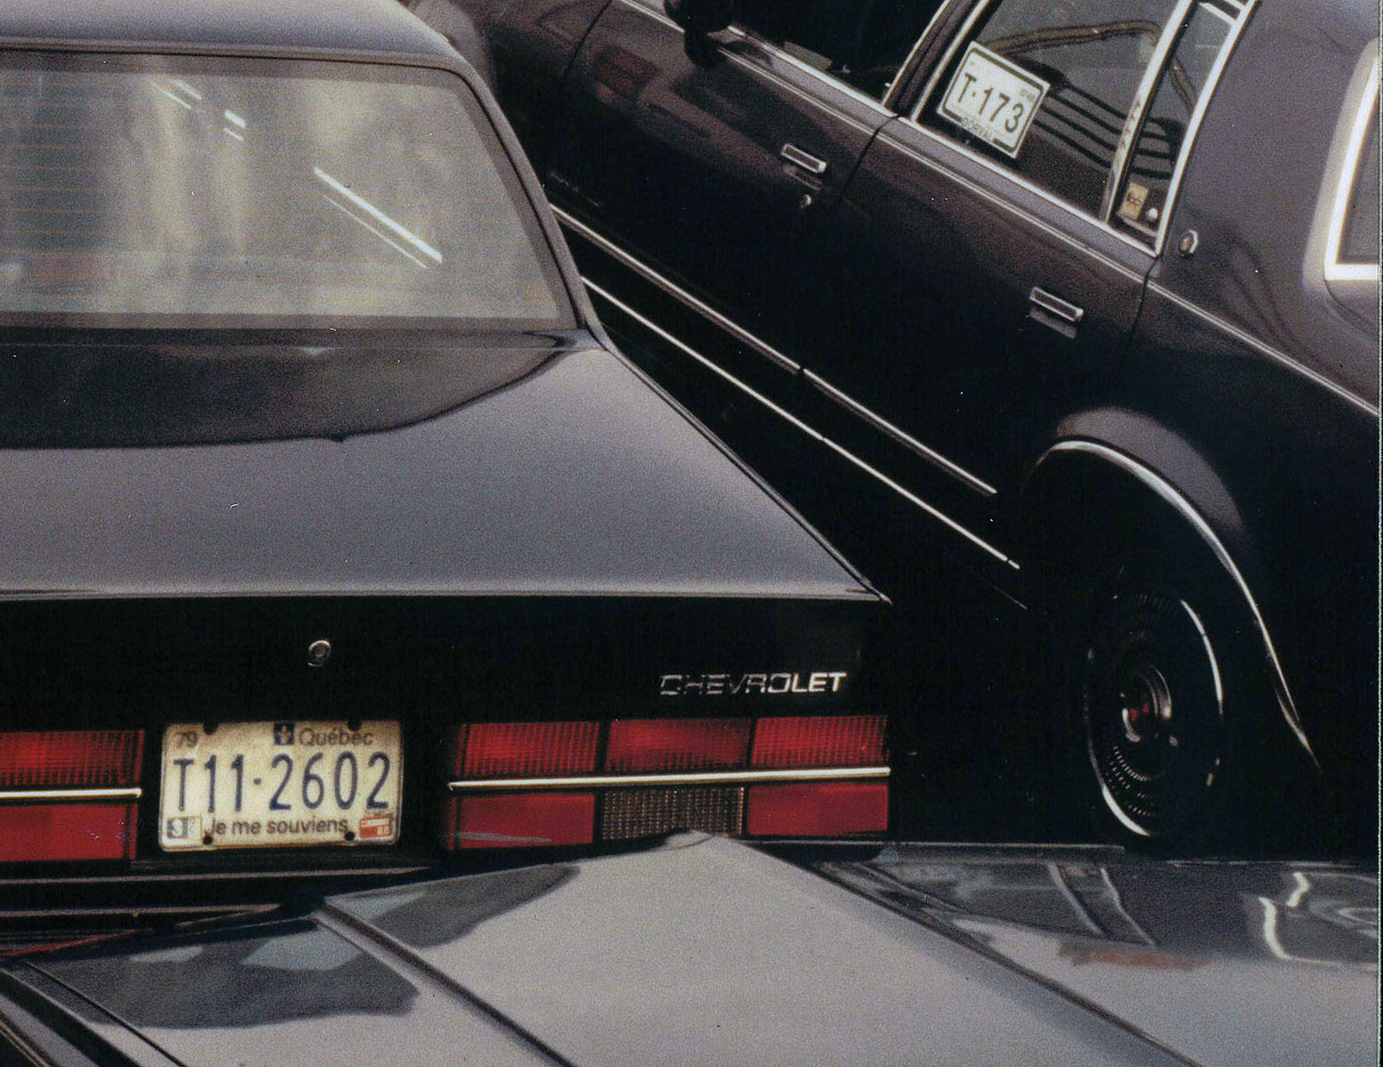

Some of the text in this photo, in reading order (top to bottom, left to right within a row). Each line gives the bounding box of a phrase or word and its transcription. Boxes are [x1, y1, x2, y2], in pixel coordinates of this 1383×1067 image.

[957, 72, 1024, 133] T-173
[659, 672, 848, 696] CHEVROLET
[175, 728, 374, 747] 79 Québec
[172, 751, 391, 814] T11-2602
[231, 820, 263, 835] me
[266, 816, 349, 834] souviens
